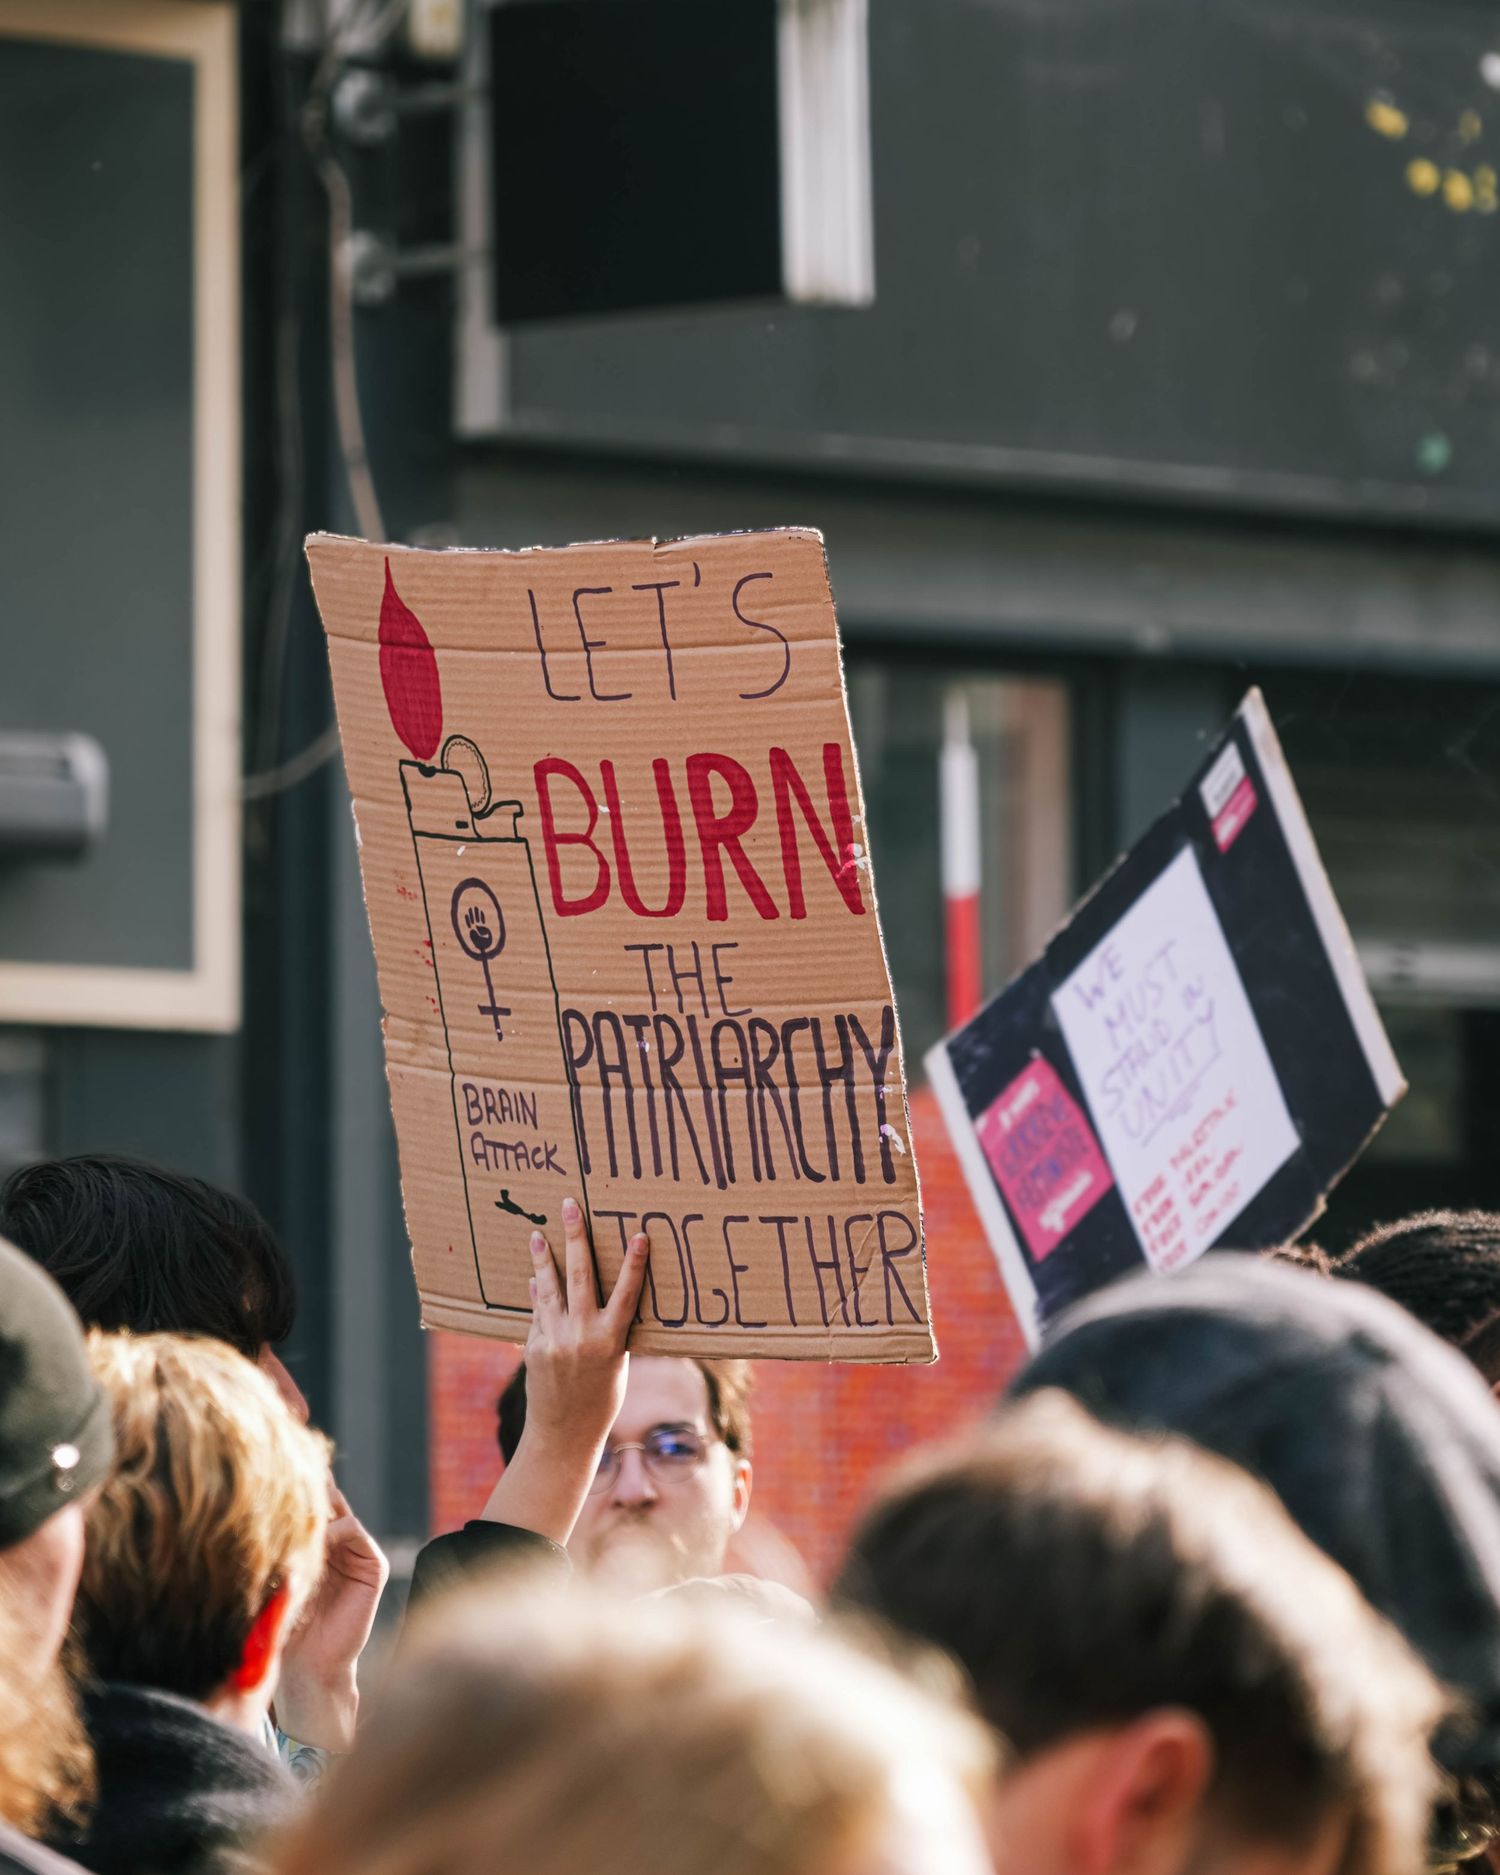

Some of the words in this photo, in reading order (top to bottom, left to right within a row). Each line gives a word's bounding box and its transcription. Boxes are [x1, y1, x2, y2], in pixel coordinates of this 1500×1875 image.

[528, 561, 791, 701] LET'S
[533, 742, 867, 921] BURN
[623, 941, 753, 1018] THE
[1104, 938, 1178, 1051] MUST
[463, 1083, 538, 1131] BRAIN
[470, 1131, 567, 1176] ATTACK
[561, 1004, 897, 1190] PATRIARCHY
[592, 1209, 924, 1329] TOGETHER
